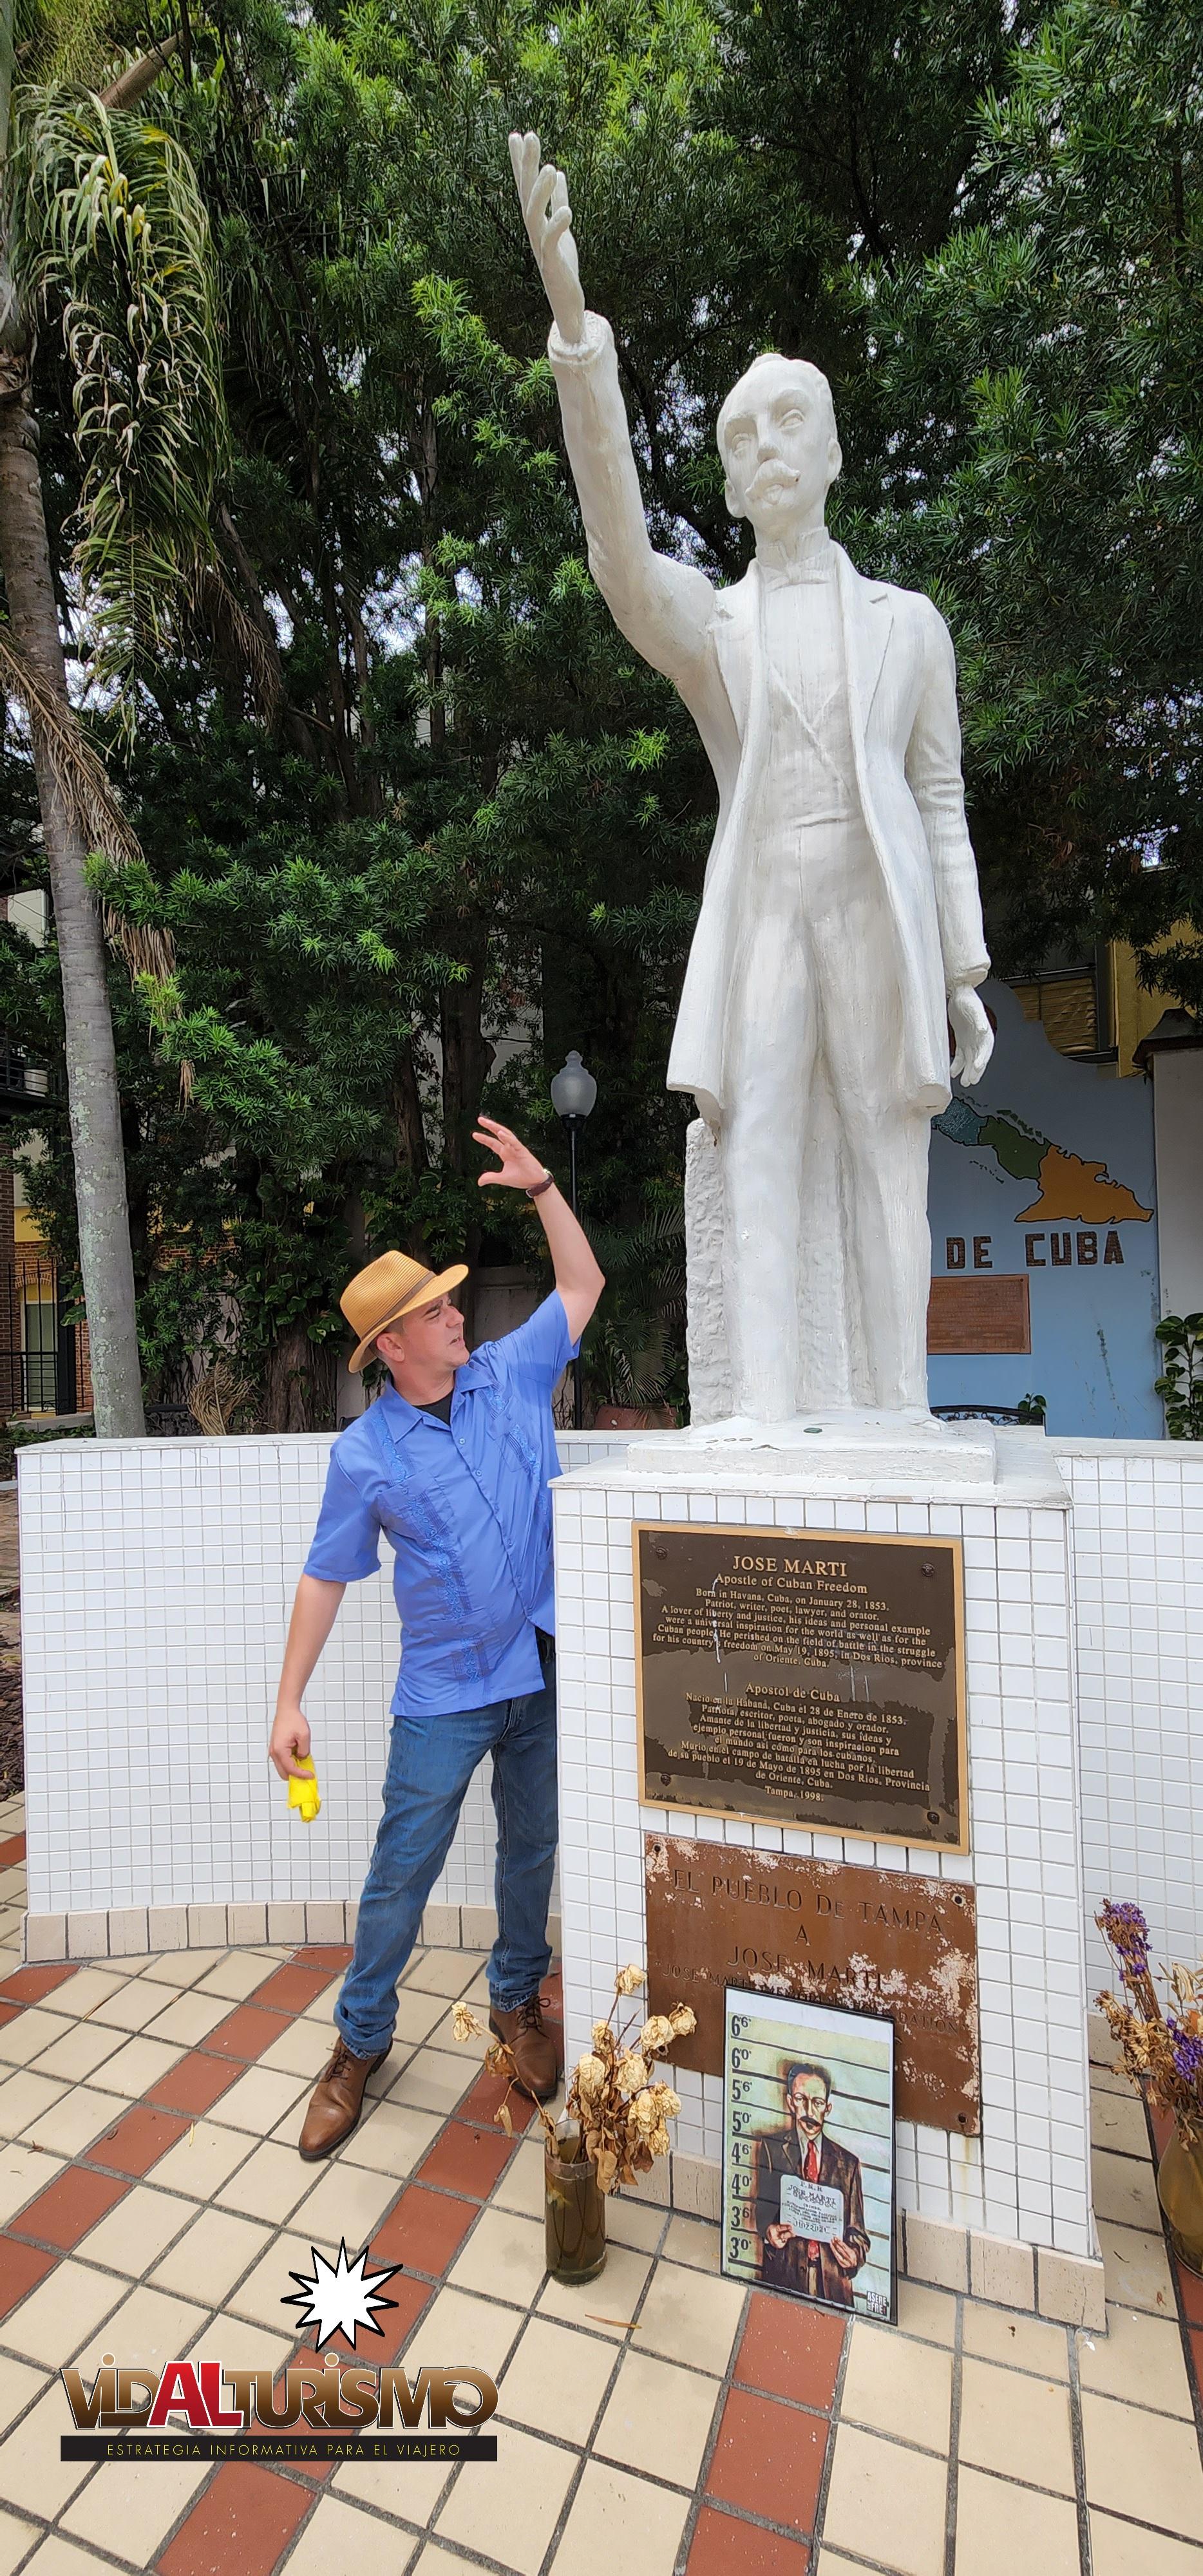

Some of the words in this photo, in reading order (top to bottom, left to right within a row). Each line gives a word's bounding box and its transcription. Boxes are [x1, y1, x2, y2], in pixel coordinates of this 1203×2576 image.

[946, 1236, 994, 1269] DE
[1025, 1230, 1125, 1267] CUBA
[733, 1556, 778, 1573] JOSE
[783, 1559, 847, 1577] MARTI
[716, 1573, 757, 1587] Apostle
[761, 1577, 773, 1587] of
[777, 1577, 813, 1589] Cuban
[817, 1580, 868, 1593] Freedom
[719, 1589, 727, 1598] in
[809, 1596, 843, 1610] January
[661, 1605, 668, 1613] A
[671, 1605, 691, 1615] lover
[694, 1608, 704, 1616] of
[737, 1612, 751, 1620] and
[789, 1615, 802, 1625] his
[805, 1616, 828, 1627] ideas
[831, 1620, 846, 1628] and
[849, 1622, 888, 1632] personal
[891, 1625, 931, 1636] example
[830, 1609, 846, 1618] and
[658, 1624, 683, 1634] Cuban
[720, 1629, 731, 1638] He
[734, 1631, 770, 1642] perished
[786, 1636, 800, 1644] the
[803, 1636, 823, 1647] field
[826, 1639, 835, 1647] of
[839, 1640, 864, 1651] battle
[868, 1642, 876, 1651] in
[880, 1644, 894, 1653] the
[898, 1646, 935, 1658] struggle
[736, 1621, 782, 1633] inspiration
[786, 1625, 799, 1634] for
[801, 1627, 815, 1636] the
[818, 1629, 843, 1638] world
[860, 1633, 878, 1642] well
[895, 1634, 909, 1644] for
[912, 1636, 927, 1645] the
[653, 1633, 665, 1642] for
[668, 1634, 679, 1643] his
[724, 1639, 757, 1651] freedom
[775, 1644, 793, 1656] May
[841, 1650, 849, 1659] in
[853, 1651, 871, 1661] Dos
[901, 1658, 942, 1667] province
[753, 1653, 763, 1662] of
[793, 1688, 807, 1699] de
[811, 1690, 840, 1702] Cuba
[726, 1696, 733, 1705] la
[773, 1702, 795, 1712] Cuba
[799, 1705, 806, 1714] el
[810, 1706, 820, 1715] 28
[824, 1707, 833, 1716] de
[837, 1709, 864, 1720] Enero
[866, 1712, 877, 1721] de
[700, 1713, 731, 1725] Amante
[734, 1718, 744, 1727] de
[747, 1719, 755, 1728] la
[758, 1720, 791, 1732] libertad
[794, 1726, 799, 1735] y
[859, 1732, 883, 1743] ideas
[886, 1737, 891, 1746] y
[808, 1717, 844, 1728] abogado
[848, 1723, 853, 1732] y
[694, 1723, 726, 1735] ejemplo
[729, 1728, 765, 1739] personal
[768, 1731, 796, 1743] fueron
[799, 1737, 804, 1746] y
[879, 1747, 900, 1756] para
[715, 1736, 723, 1744] el
[726, 1738, 753, 1748] mundo
[798, 1747, 817, 1756] para
[820, 1748, 832, 1757] los
[668, 1748, 677, 1757] de
[692, 1753, 720, 1763] pueblo
[723, 1756, 730, 1765] el
[734, 1757, 743, 1766] 19
[746, 1759, 756, 1768] de
[759, 1761, 783, 1773] Mayo
[786, 1764, 796, 1773] de
[800, 1766, 820, 1776] 1895
[837, 1771, 855, 1781] Dos
[885, 1777, 930, 1791] Provincia
[721, 1746, 728, 1754] el
[732, 1748, 759, 1760] campo
[763, 1750, 772, 1760] de
[821, 1758, 845, 1769] lucha
[849, 1764, 862, 1773] por
[866, 1764, 875, 1773] la
[878, 1766, 914, 1778] libertad
[755, 1770, 765, 1779] de
[674, 1869, 700, 1893] EL
[712, 1876, 803, 1911] PUEBLO
[817, 1894, 845, 1920] DE
[858, 1901, 943, 1933] TAMPA
[794, 1924, 811, 1947] A
[808, 1959, 882, 1991] MARTI
